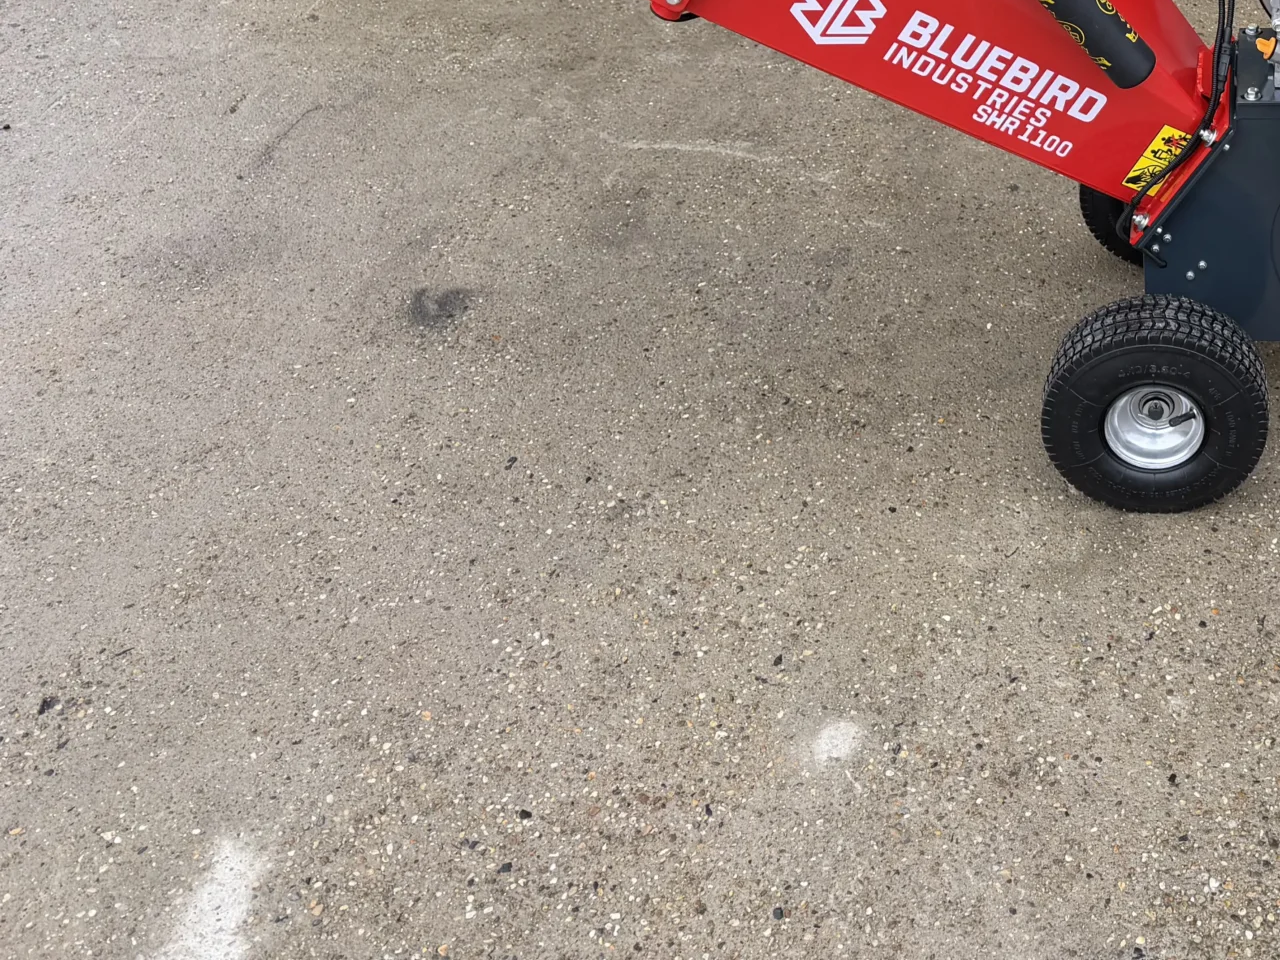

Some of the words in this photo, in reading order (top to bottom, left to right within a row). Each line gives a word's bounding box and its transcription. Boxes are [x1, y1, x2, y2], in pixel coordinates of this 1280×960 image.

[883, 42, 1052, 128] INDUSTRIES
[898, 9, 1107, 123] BLUEBIRD
[972, 104, 1021, 136] SHR
[1017, 124, 1073, 158] 1100
